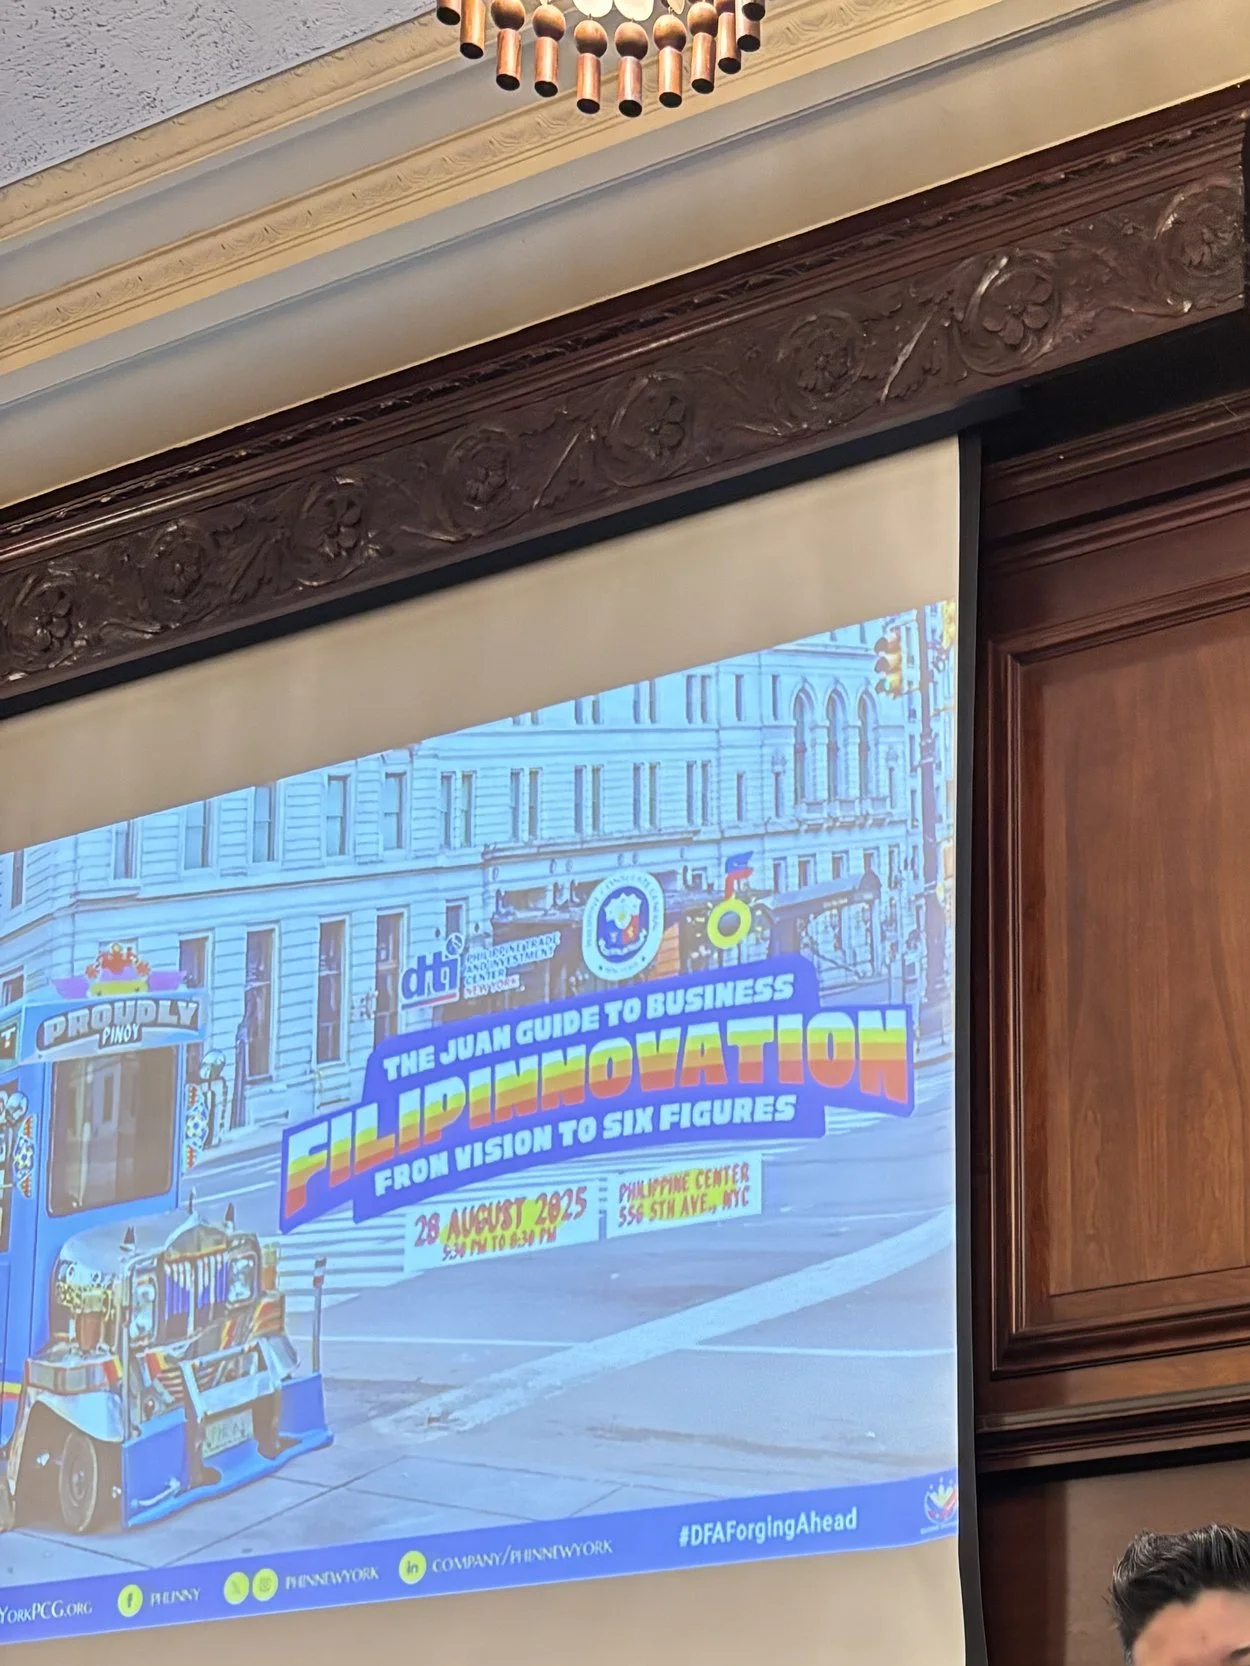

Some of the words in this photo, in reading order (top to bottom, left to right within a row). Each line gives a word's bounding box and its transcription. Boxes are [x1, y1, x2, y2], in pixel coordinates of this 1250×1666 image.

[44, 999, 199, 1046] PROUDLY
[102, 1024, 141, 1045] PINOY
[383, 1045, 435, 1081] THE
[440, 1025, 511, 1065] JUAN
[516, 1005, 600, 1045] GUIDE
[604, 997, 641, 1027] TO
[646, 973, 795, 1020] BUSINESS
[284, 1009, 909, 1219] FILIPINNOVATION
[374, 1151, 449, 1196] FROM
[454, 1125, 552, 1171] VISION
[558, 1116, 597, 1147] TO
[603, 1106, 654, 1140] SIX
[659, 1094, 797, 1131] FIGURES
[619, 1172, 690, 1203] PHILIPPINE
[695, 1161, 750, 1190] CENTER
[649, 1195, 675, 1222] 5TH
[722, 1185, 750, 1210] NYC
[414, 1212, 440, 1247] 28
[446, 1196, 527, 1243] AUGUST
[535, 1185, 588, 1226] 2025
[470, 1237, 487, 1257] PM
[491, 1234, 505, 1251] TO
[539, 1226, 557, 1245] PM
[679, 1506, 858, 1547] #DFAForgingAhead
